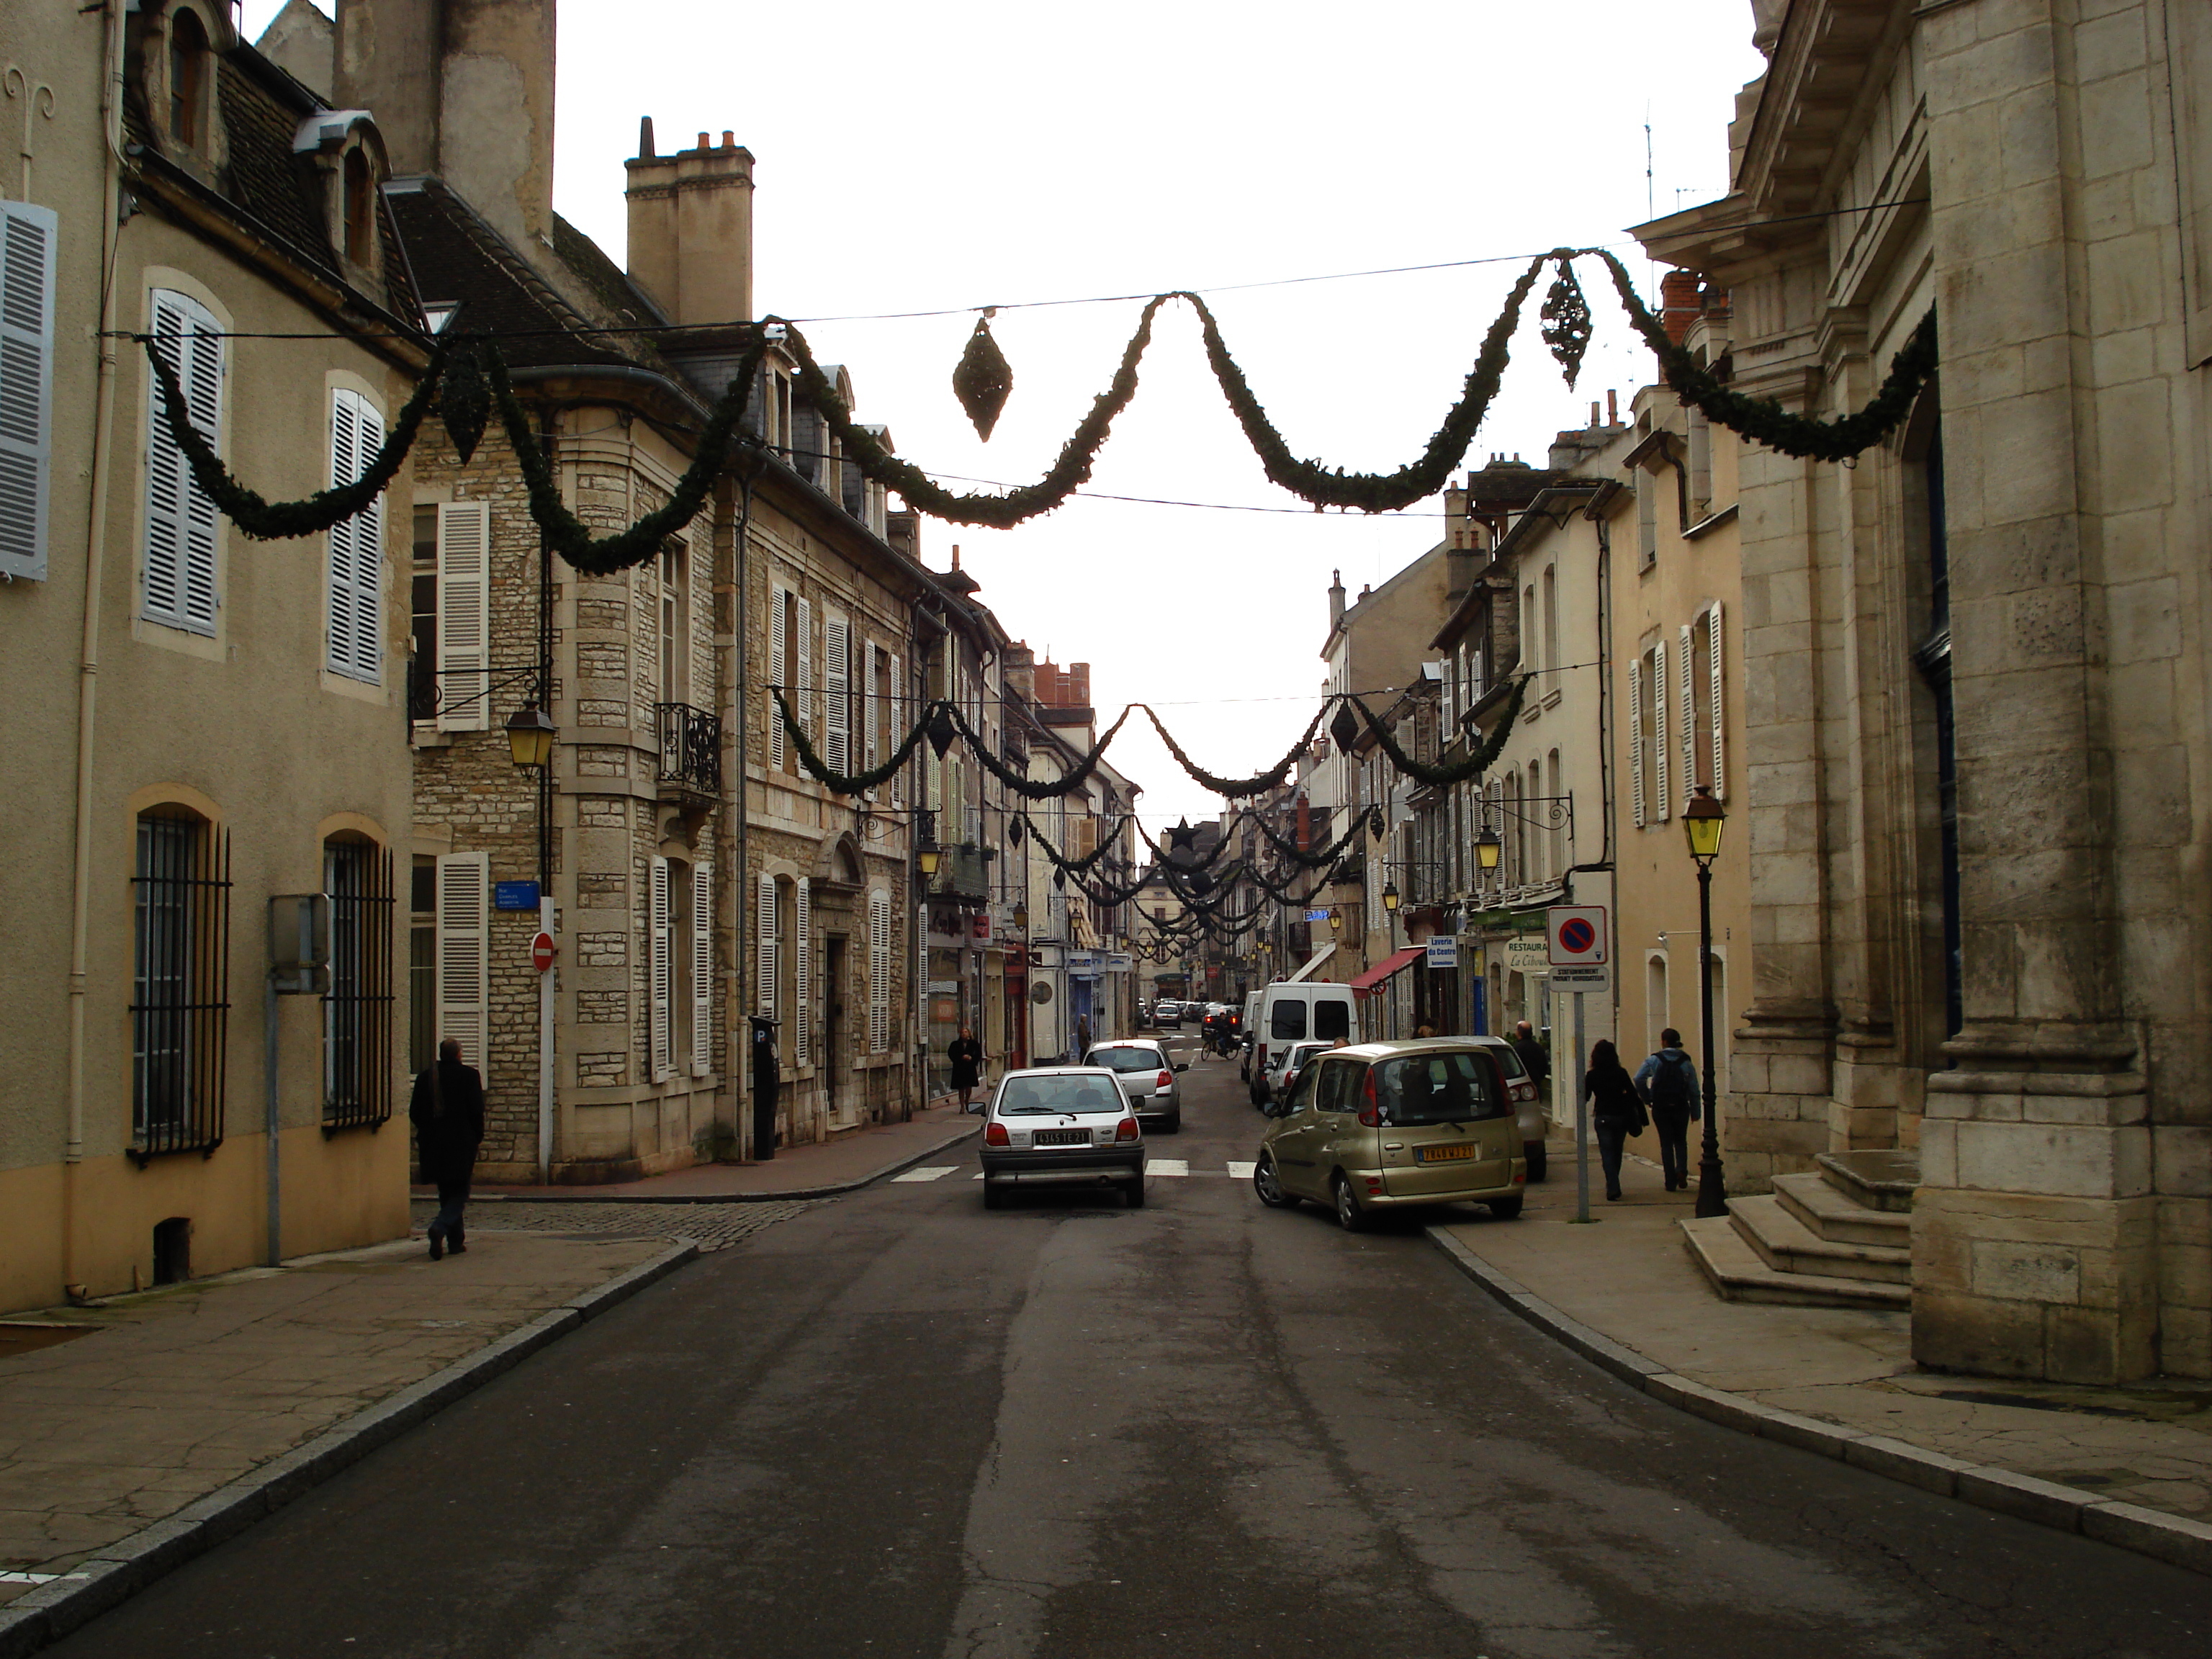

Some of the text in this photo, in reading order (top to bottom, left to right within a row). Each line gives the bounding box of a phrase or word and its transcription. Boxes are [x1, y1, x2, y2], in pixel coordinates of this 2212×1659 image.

[1304, 910, 1329, 921] BAR
[1510, 955, 1548, 966] La Ciboul
[757, 1030, 765, 1043] P
[1039, 1133, 1084, 1143] 4345 TE 21
[1462, 1146, 1472, 1156] 21
